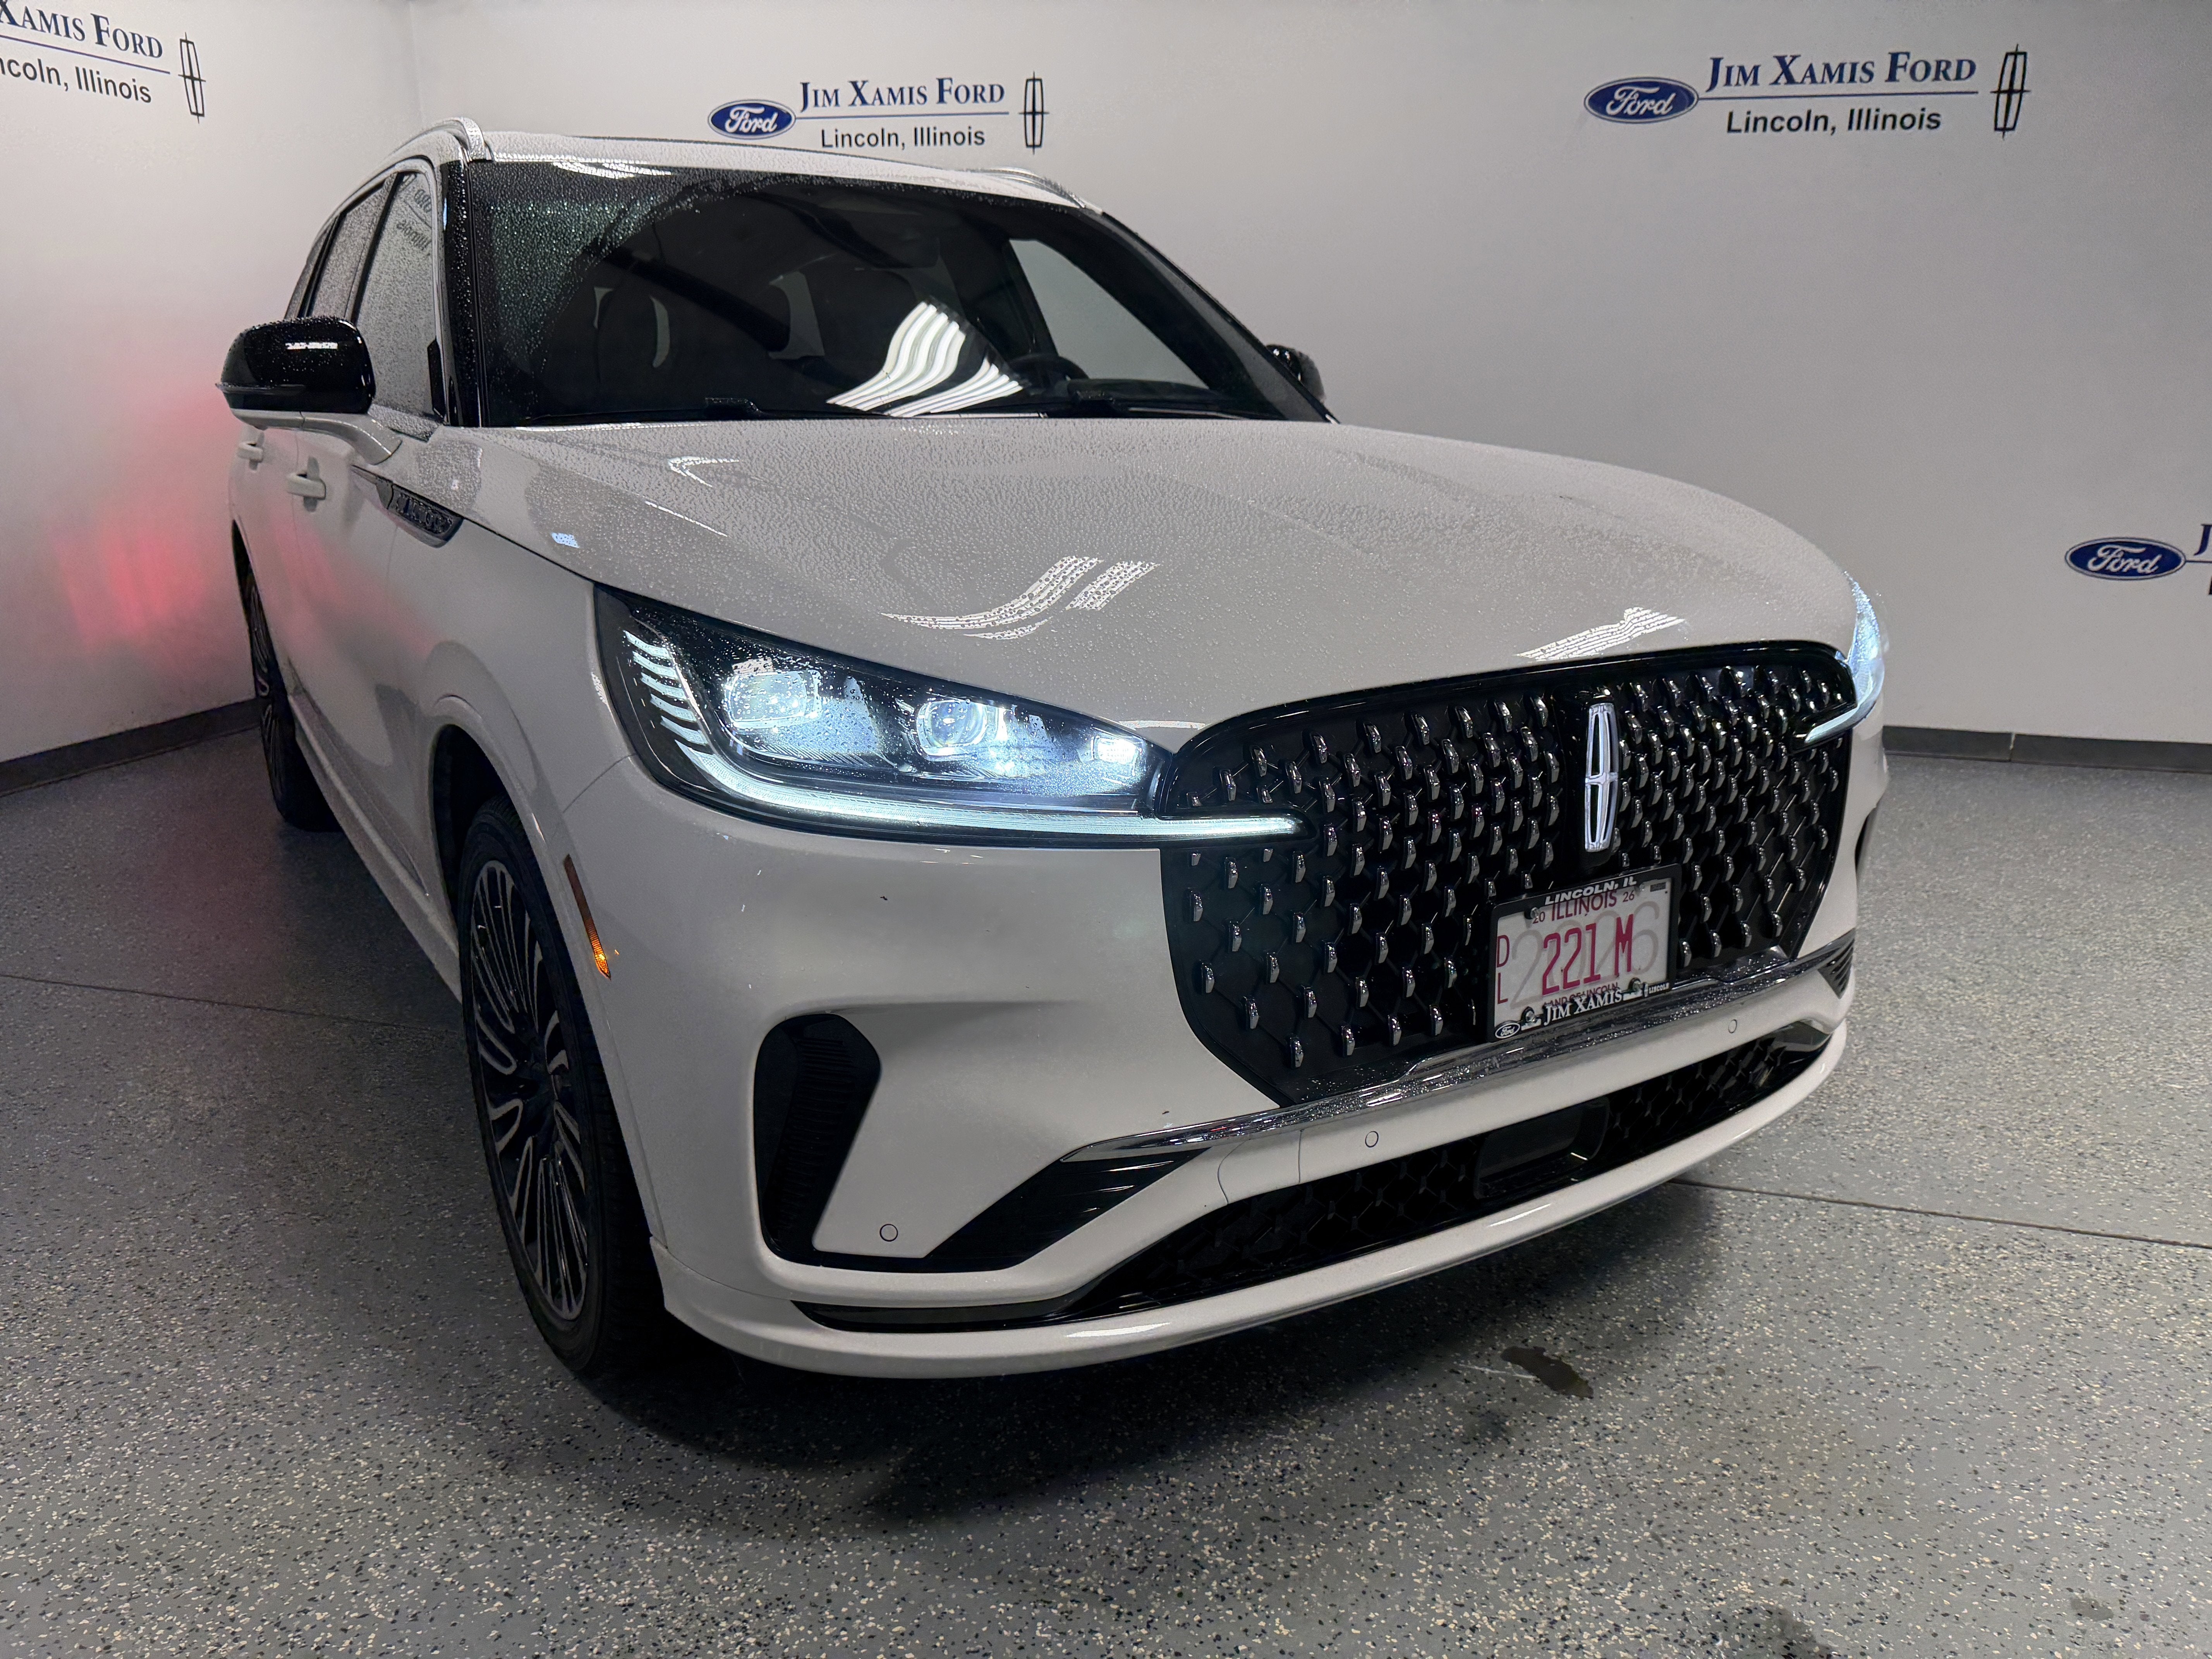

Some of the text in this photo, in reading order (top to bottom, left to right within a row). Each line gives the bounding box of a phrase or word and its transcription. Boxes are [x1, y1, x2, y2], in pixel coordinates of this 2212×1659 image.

[90, 13, 163, 58] FORD
[75, 66, 151, 103] Illinois
[1705, 51, 1976, 93] JIM XAMIS FORD
[800, 77, 1005, 112] JIM XAMIS FORD
[1606, 86, 1676, 115] Ford
[725, 106, 778, 133] Ford
[1727, 107, 1941, 136] Lincoln, Illinois
[821, 127, 985, 150] Lincoln, Illinois
[2087, 544, 2162, 574] Ford
[1544, 876, 1637, 905] LINCOLN, IL
[1551, 891, 1617, 921] ILLINOIS
[1622, 891, 1635, 903] 26
[1542, 914, 1633, 995] 221 M
[1649, 983, 1669, 994] LINCOLN
[1544, 989, 1623, 1026] JIM XAMIS
